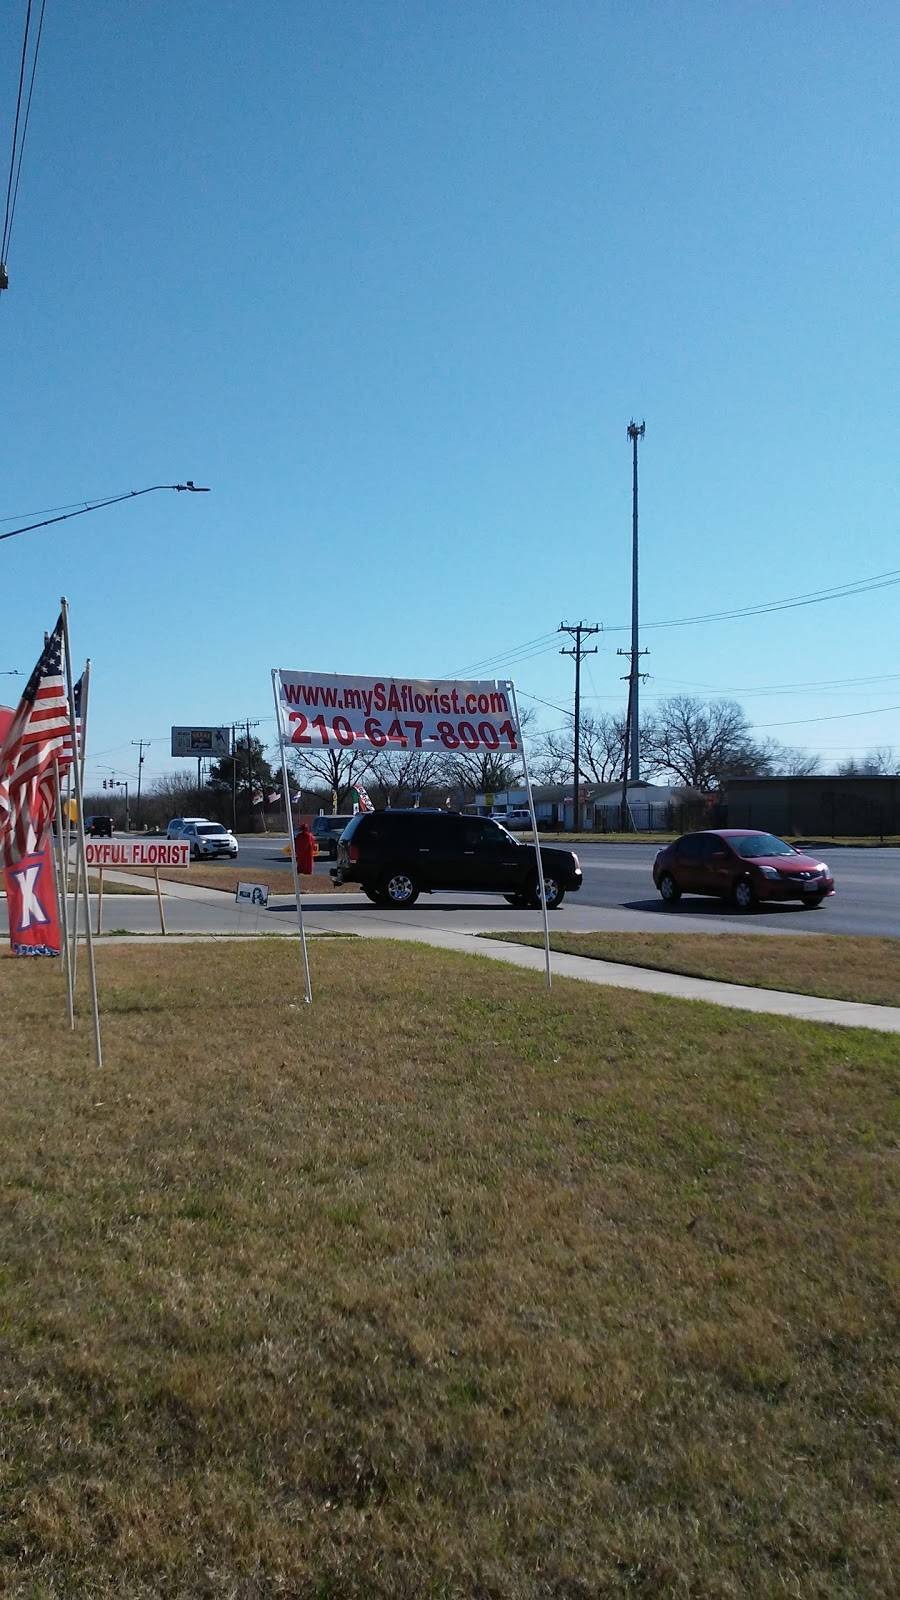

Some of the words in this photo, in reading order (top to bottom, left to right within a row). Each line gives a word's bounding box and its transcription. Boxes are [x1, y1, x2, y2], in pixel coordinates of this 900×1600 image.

[283, 682, 509, 717] www.mySAflorist.com
[288, 711, 518, 750] 210-647-8001
[85, 844, 128, 864] OYFUL
[132, 845, 189, 864] FLORIST
